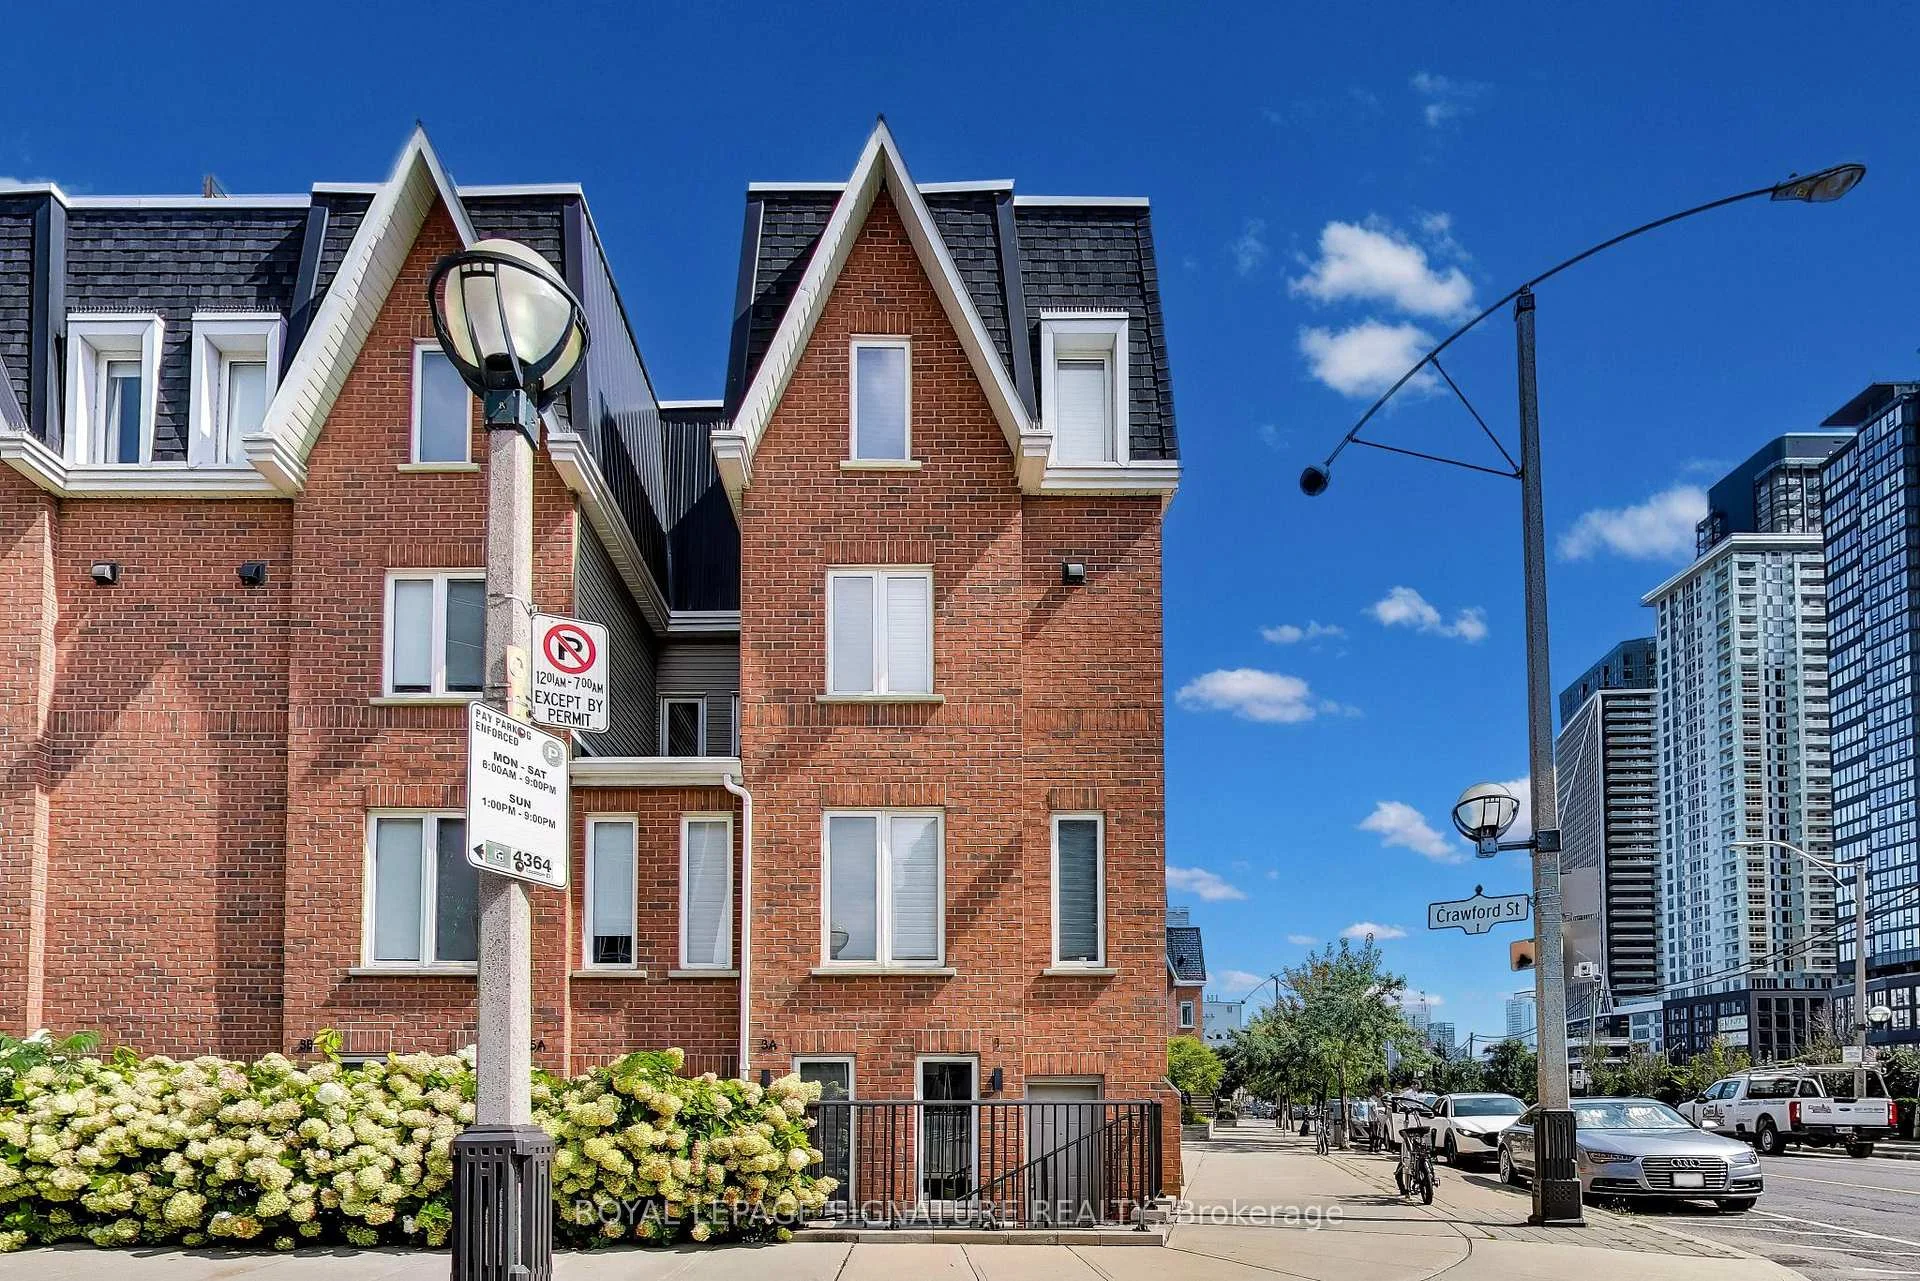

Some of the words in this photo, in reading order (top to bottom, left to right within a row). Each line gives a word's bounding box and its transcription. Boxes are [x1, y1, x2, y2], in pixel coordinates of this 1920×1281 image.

[535, 690, 582, 709] EXCEPT
[588, 698, 604, 713] BY
[475, 708, 493, 724] PAY
[495, 717, 532, 741] PARKG
[548, 708, 591, 727] PERMIT
[475, 720, 519, 746] ENFORCED
[493, 751, 519, 769] MON
[527, 765, 547, 779] SAT
[482, 760, 517, 780] 8:00AM
[524, 776, 557, 795] 9:00PM
[482, 797, 516, 816] 1:00PM
[524, 811, 556, 829] 9:00PM
[509, 794, 532, 809] SUN
[513, 851, 552, 872] 4364
[1436, 903, 1501, 923] Crawford
[1505, 901, 1520, 916] St
[760, 1039, 777, 1050] 3A
